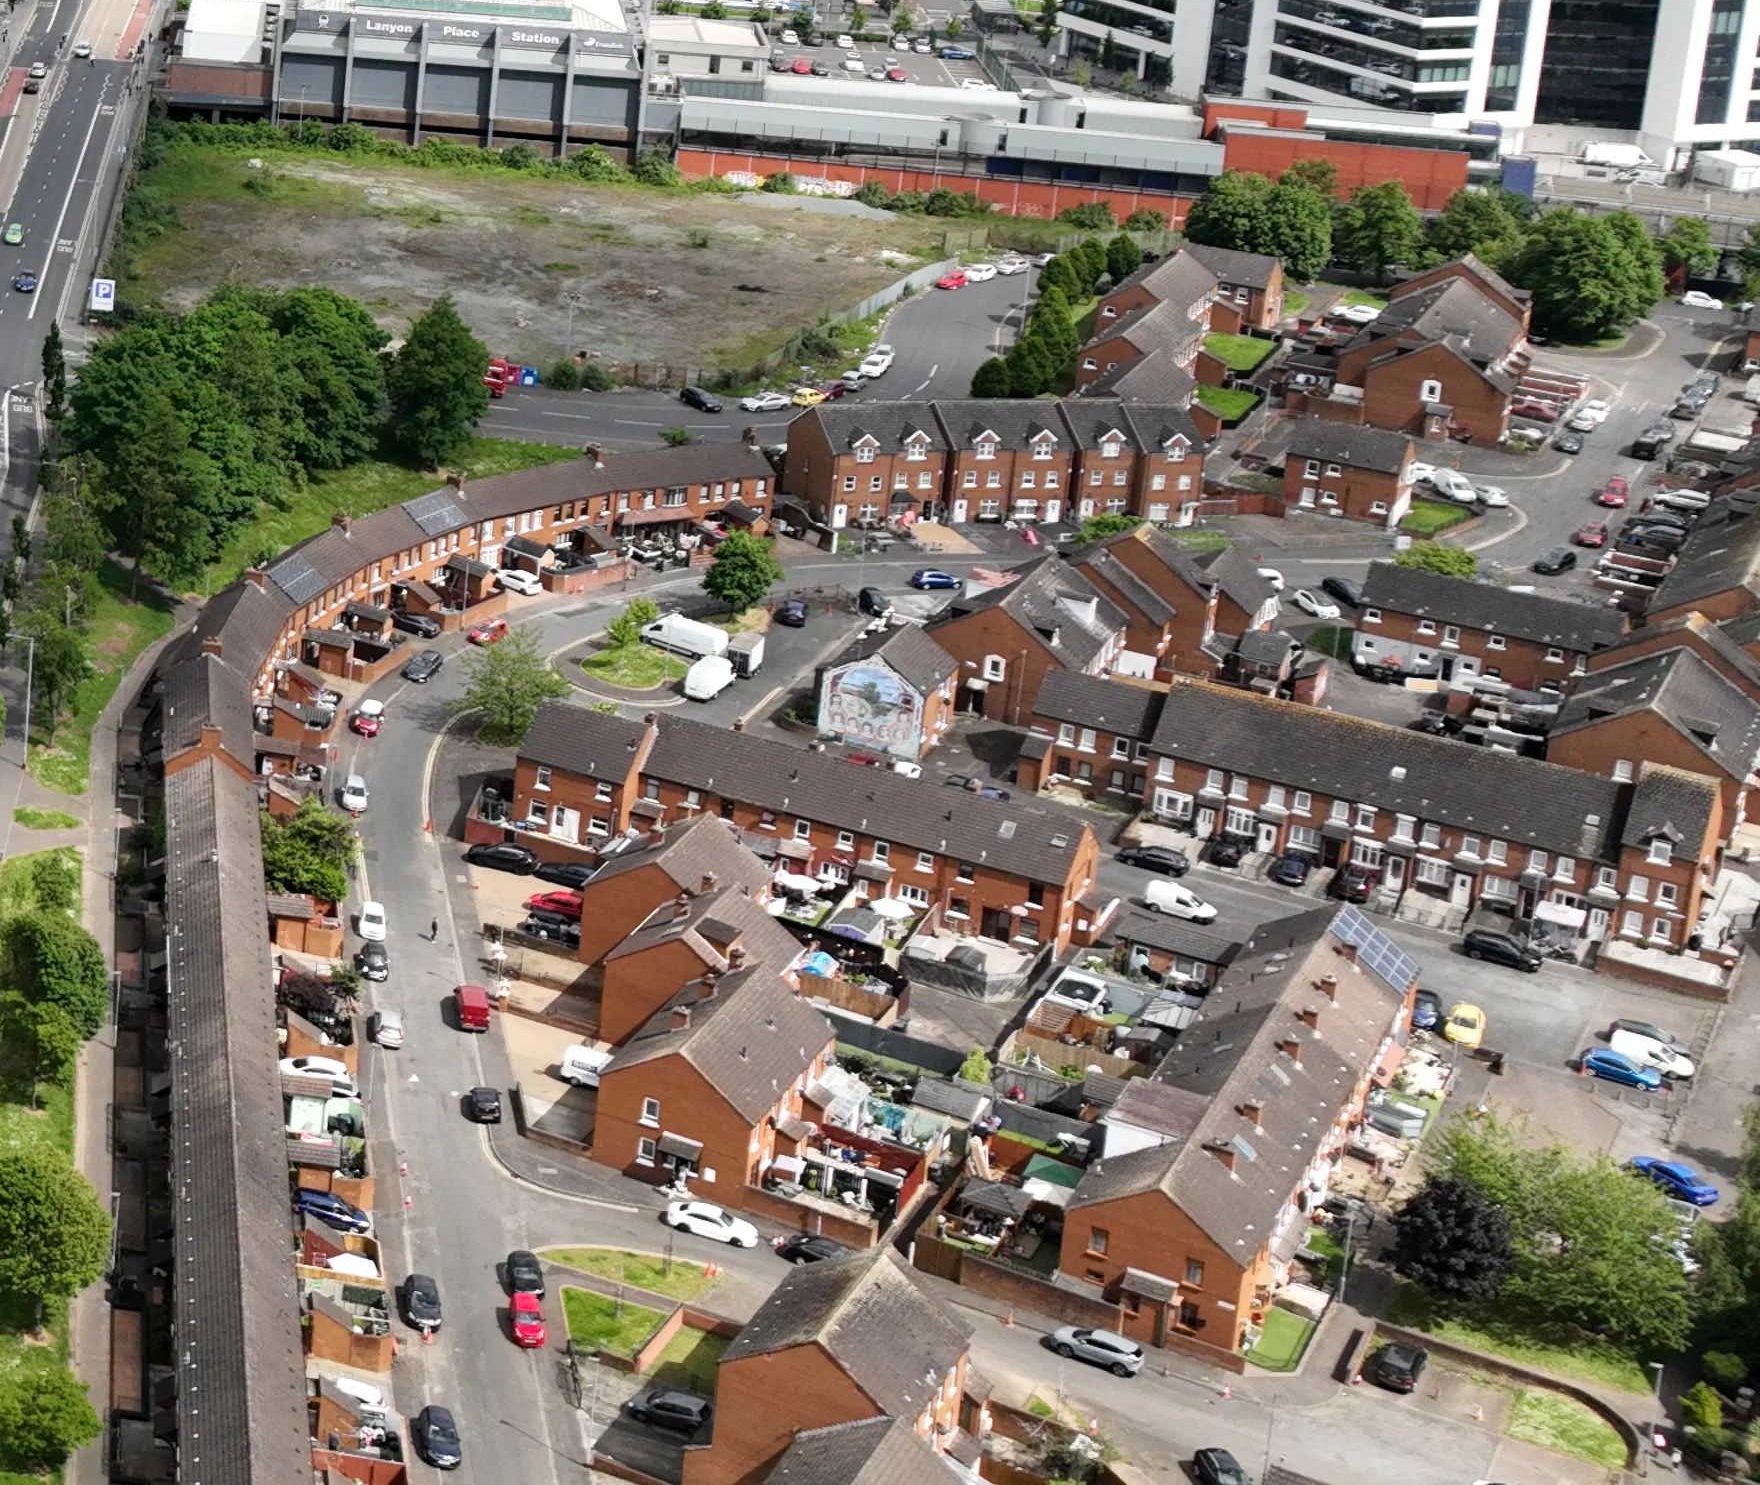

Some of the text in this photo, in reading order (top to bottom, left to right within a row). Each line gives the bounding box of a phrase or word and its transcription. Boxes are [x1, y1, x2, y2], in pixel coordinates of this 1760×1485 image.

[366, 19, 560, 45] Lanyon Place Station
[99, 283, 111, 297] P
